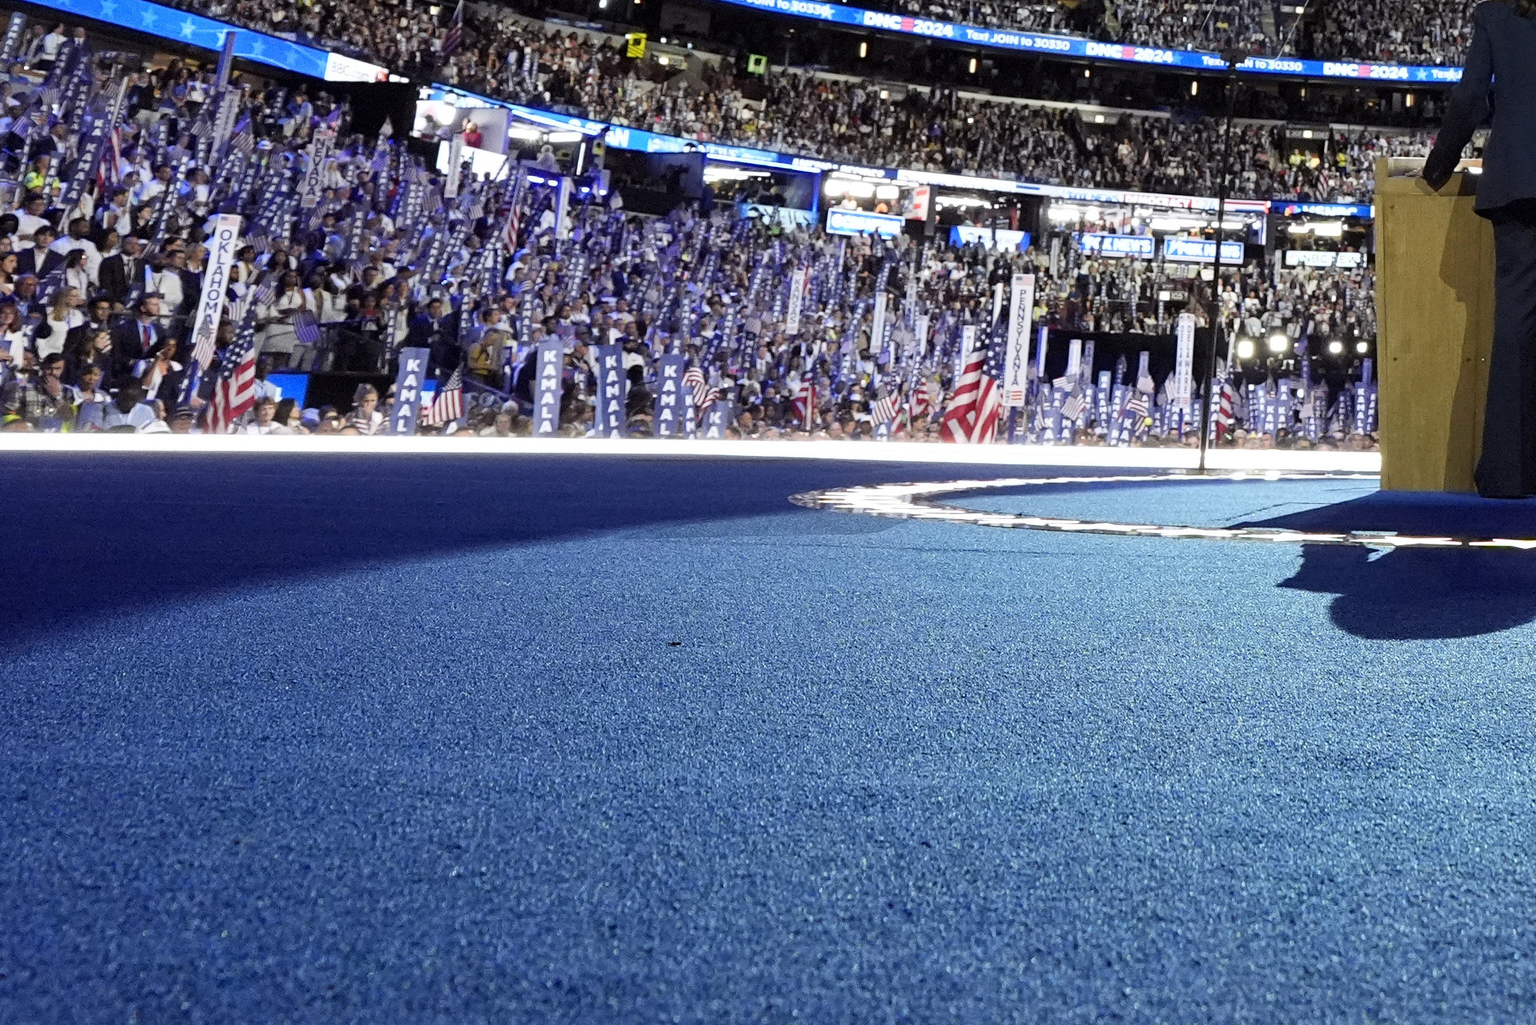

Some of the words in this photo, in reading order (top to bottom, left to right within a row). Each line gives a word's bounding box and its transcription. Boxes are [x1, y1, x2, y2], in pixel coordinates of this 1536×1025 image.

[863, 11, 901, 30] DNC
[913, 20, 953, 38] 2024
[966, 29, 989, 42] Text
[990, 33, 1019, 45] JOIN
[1020, 36, 1032, 47] to
[1034, 38, 1070, 51] 30330
[1086, 42, 1122, 59] DNC
[1134, 48, 1173, 64] 2024
[1324, 63, 1358, 77] DNC
[1370, 65, 1409, 79] 2024
[66, 142, 98, 201] KAMALA
[204, 229, 234, 325] OKLAHOMA
[1010, 289, 1029, 387] PENNSYLVANIA
[539, 349, 559, 433] KAMALA
